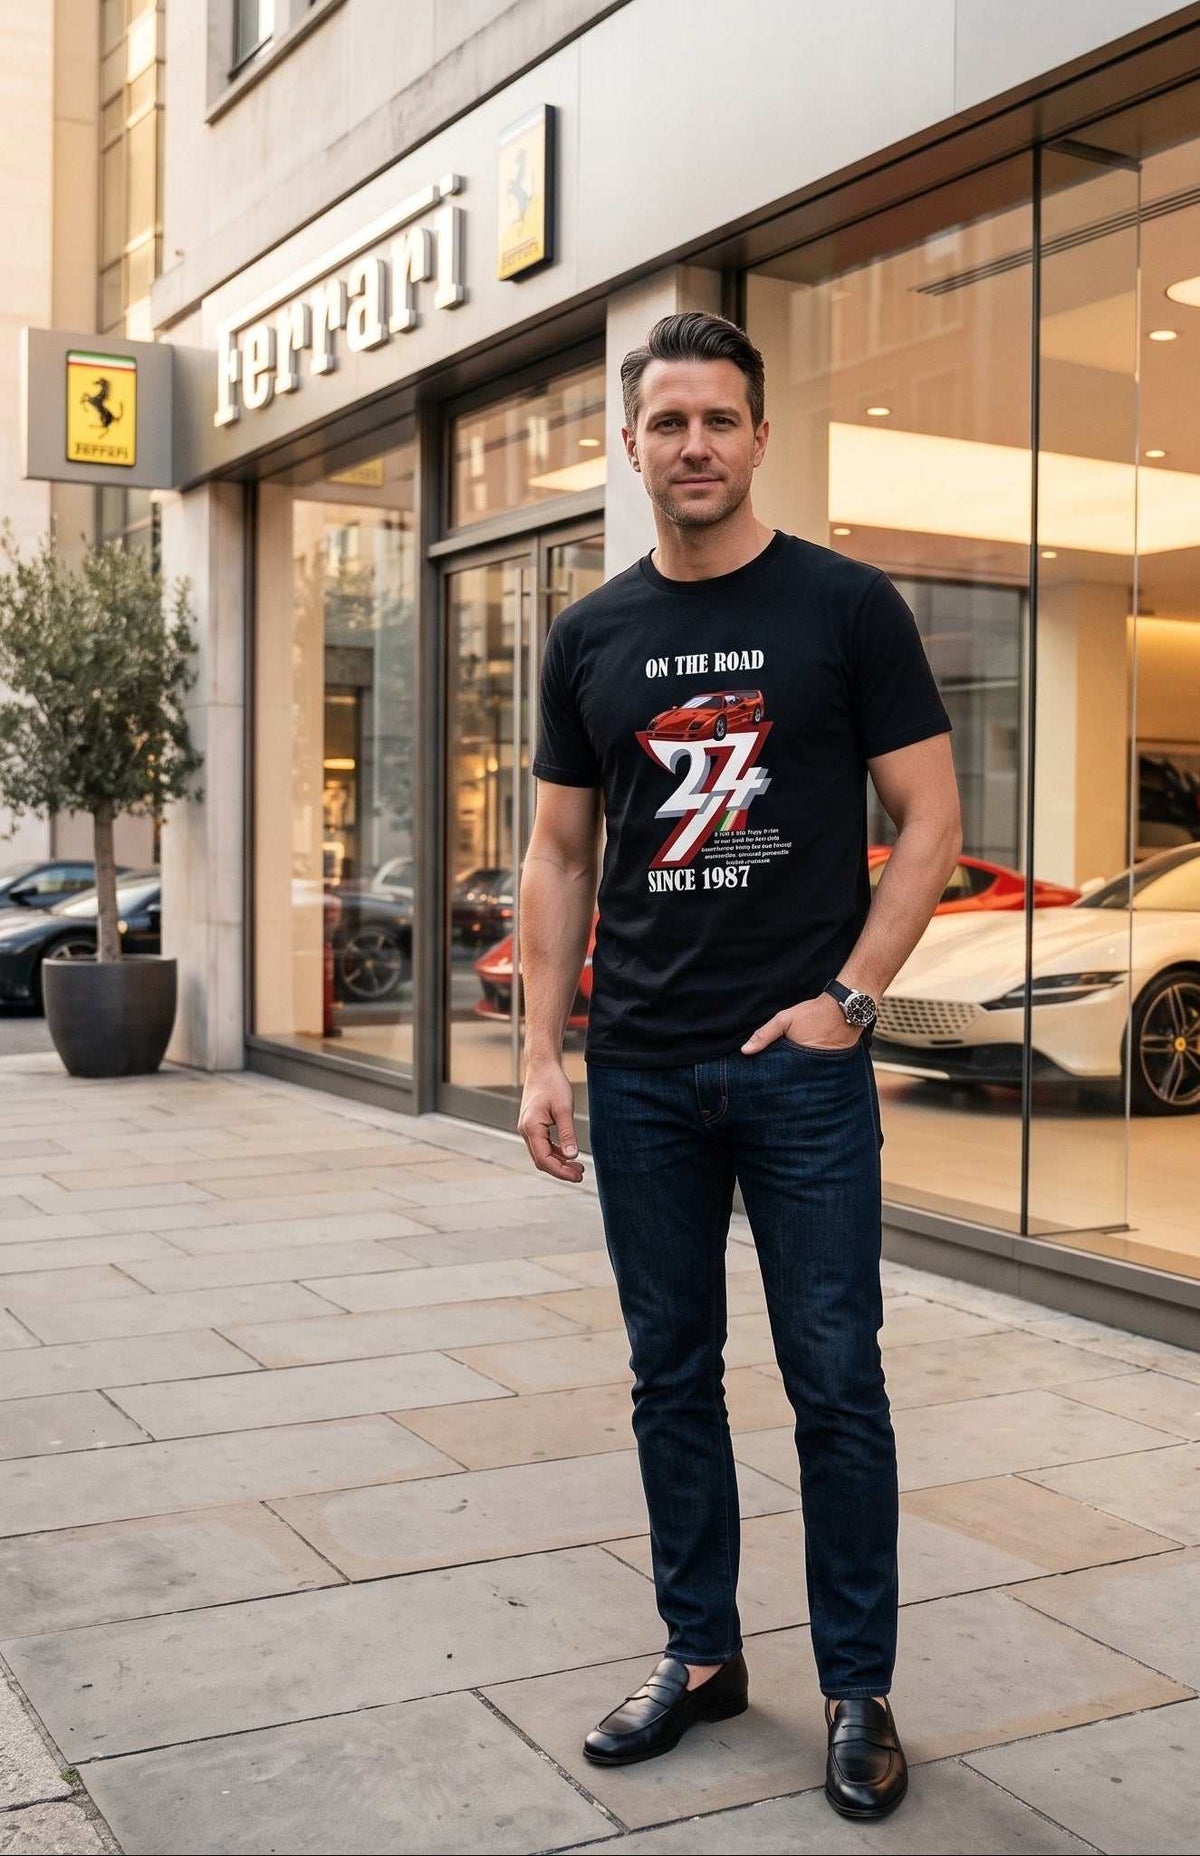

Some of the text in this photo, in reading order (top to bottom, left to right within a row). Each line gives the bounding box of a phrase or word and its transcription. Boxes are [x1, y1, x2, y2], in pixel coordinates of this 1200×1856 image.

[214, 173, 465, 427] Ferrari
[645, 649, 764, 679] ON THE ROAD
[647, 865, 750, 893] SINCE 1987
